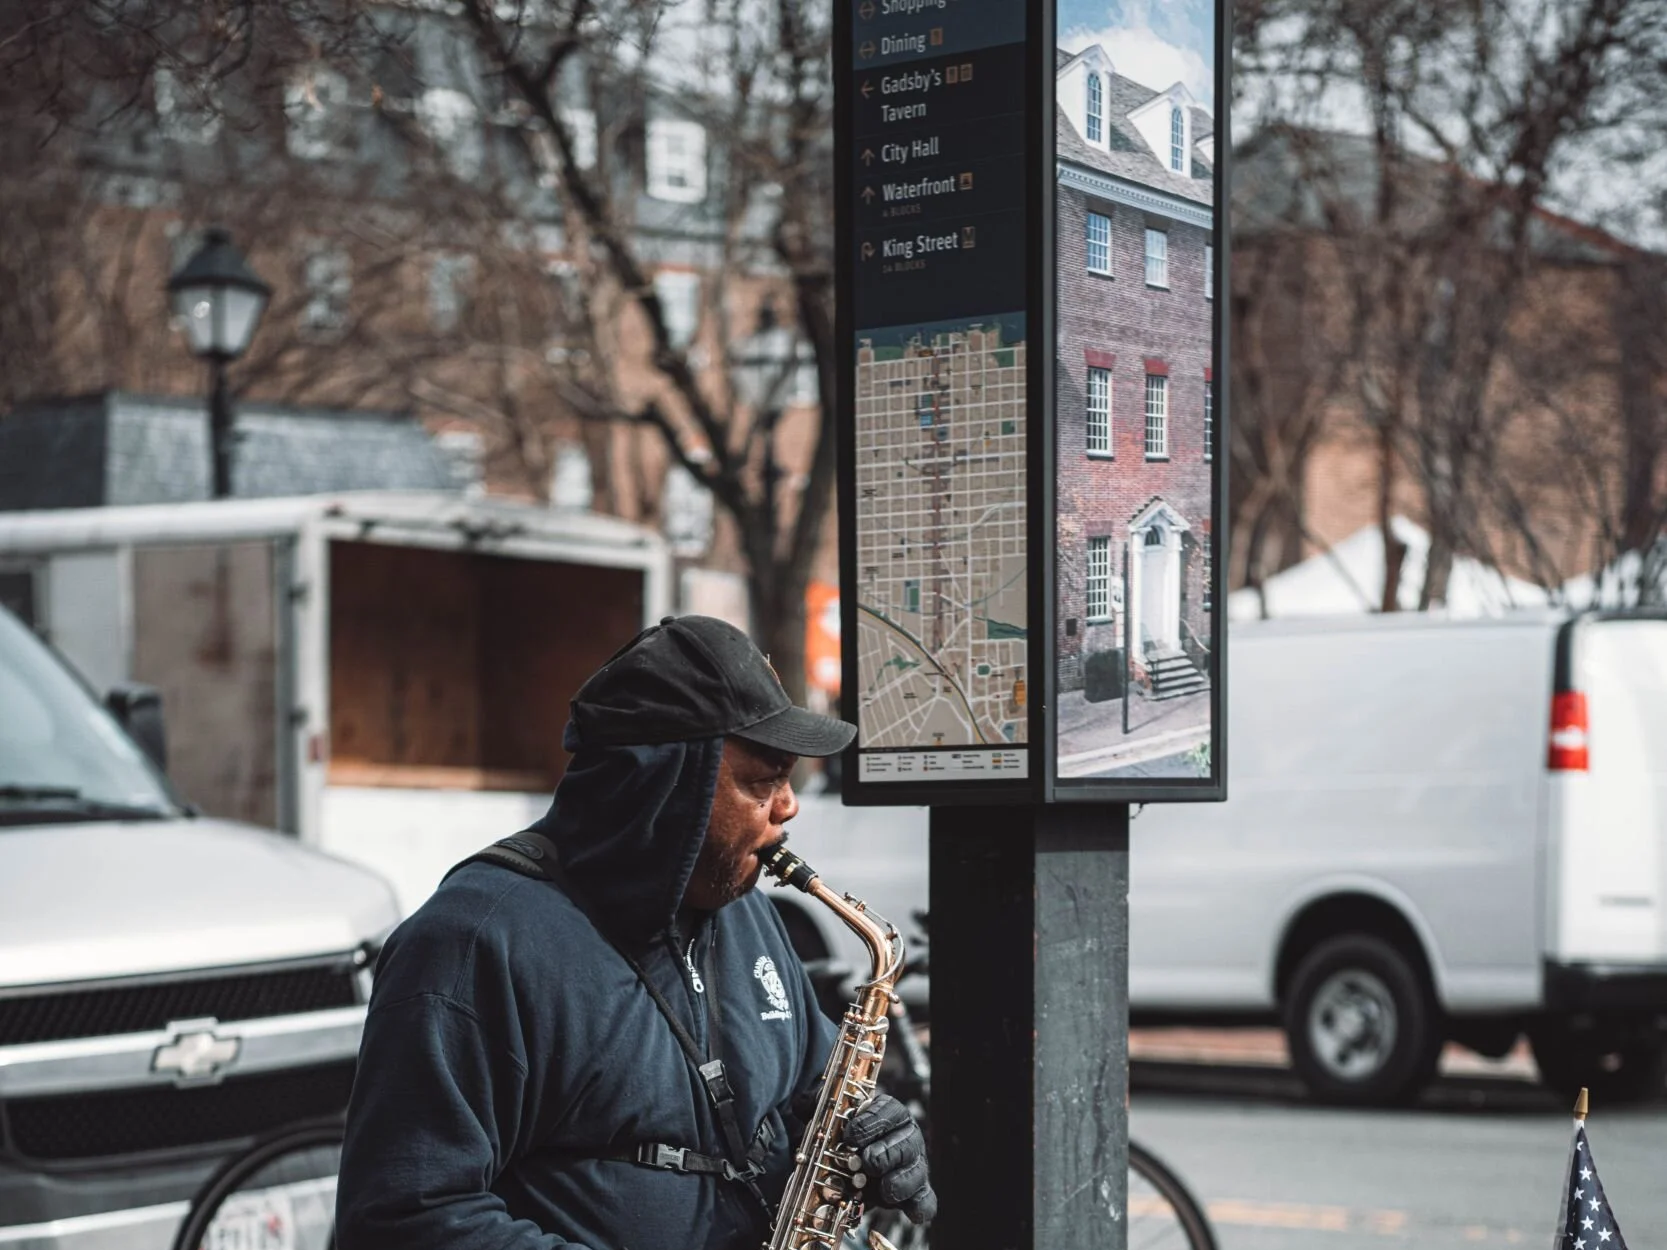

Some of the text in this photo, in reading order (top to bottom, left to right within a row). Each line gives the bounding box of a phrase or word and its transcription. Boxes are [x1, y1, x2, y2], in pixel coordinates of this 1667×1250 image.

[881, 32, 926, 55] Dining
[881, 68, 941, 94] Gadsby's
[881, 103, 926, 122] Tavern
[881, 136, 940, 164] City Hall
[882, 176, 956, 201] Waterfront
[883, 232, 958, 259] King Street
